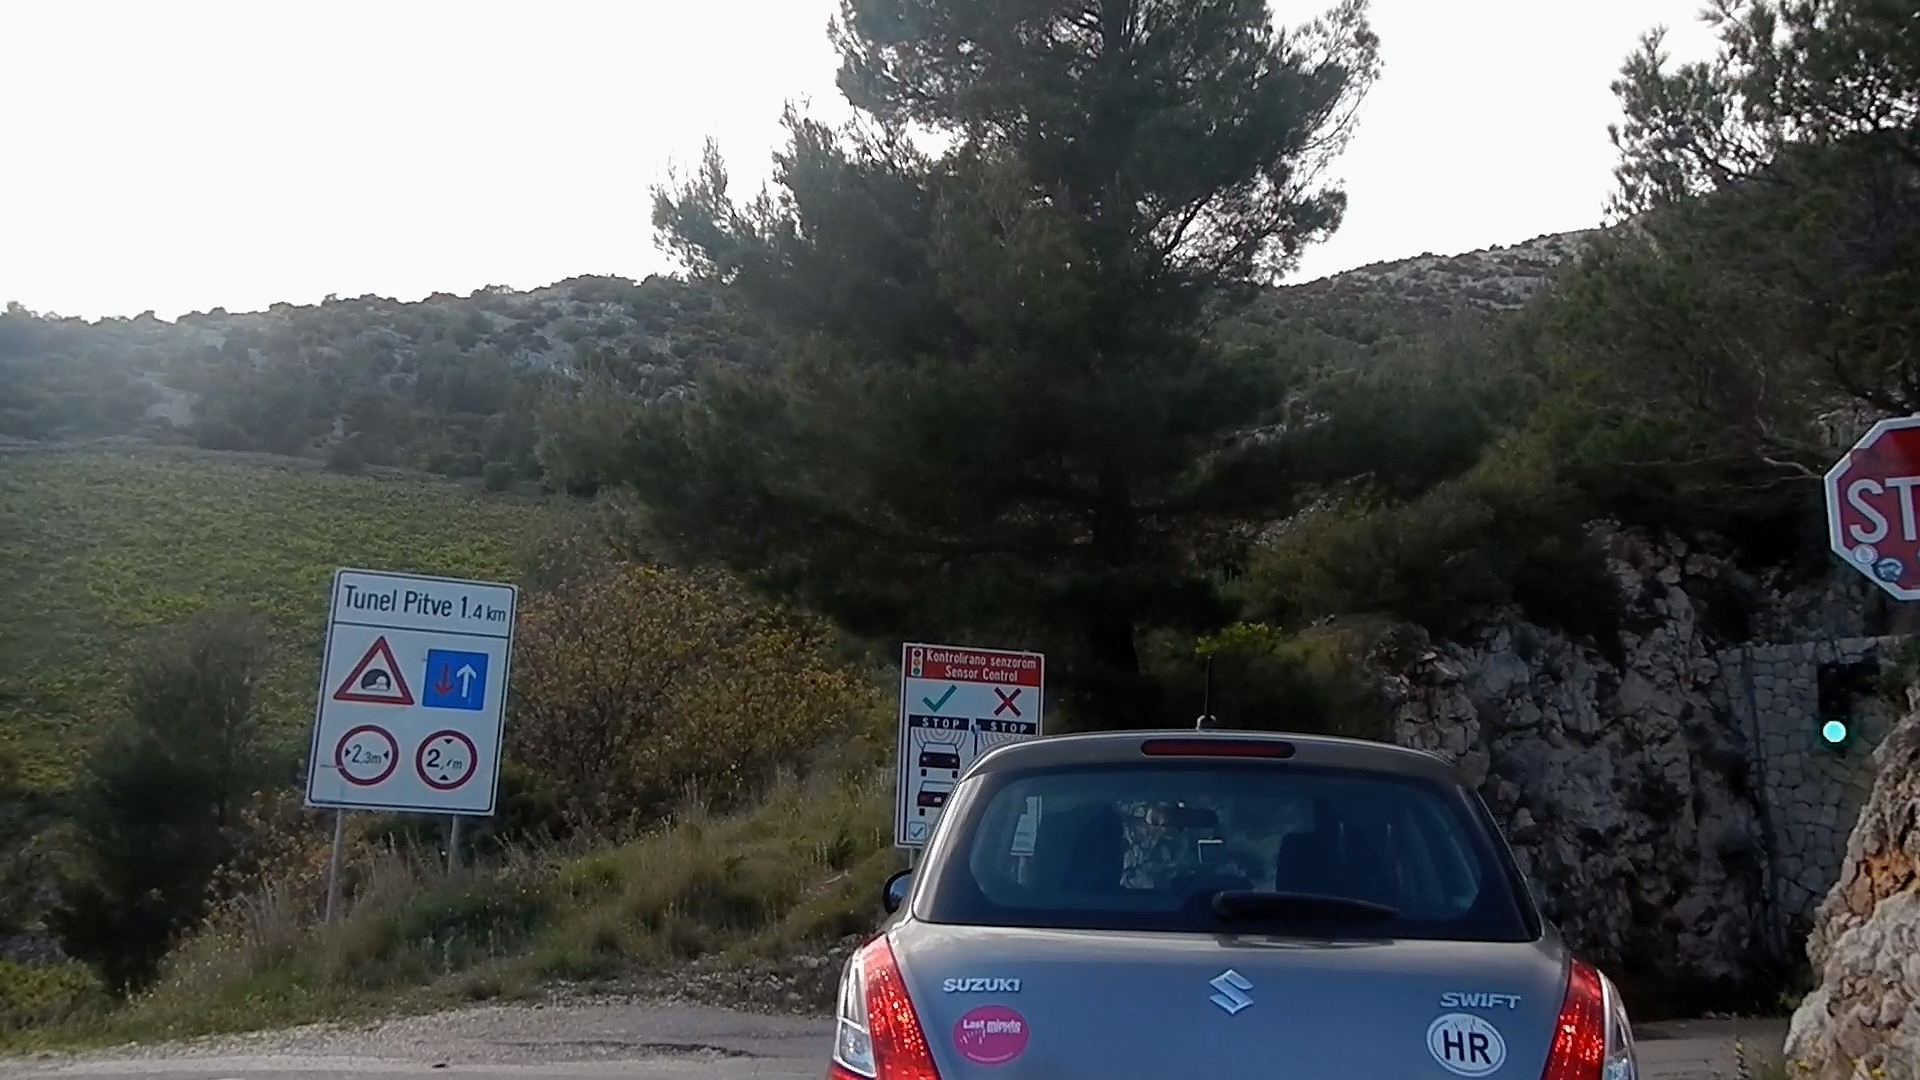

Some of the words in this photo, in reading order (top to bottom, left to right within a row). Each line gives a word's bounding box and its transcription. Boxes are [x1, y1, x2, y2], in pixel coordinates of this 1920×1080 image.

[345, 585, 398, 612] Tunel
[403, 591, 453, 617] Pitve
[486, 605, 506, 623] km
[926, 650, 986, 666] Kontrolirano
[990, 657, 1037, 669] senzorom
[945, 665, 979, 680] Sensor
[983, 668, 1018, 682] Control
[922, 719, 960, 729] STOP
[991, 723, 1027, 733] STOP
[942, 978, 1021, 992] SUZUKI
[1440, 992, 1521, 1009] SWIFT
[1443, 1029, 1491, 1064] HR
